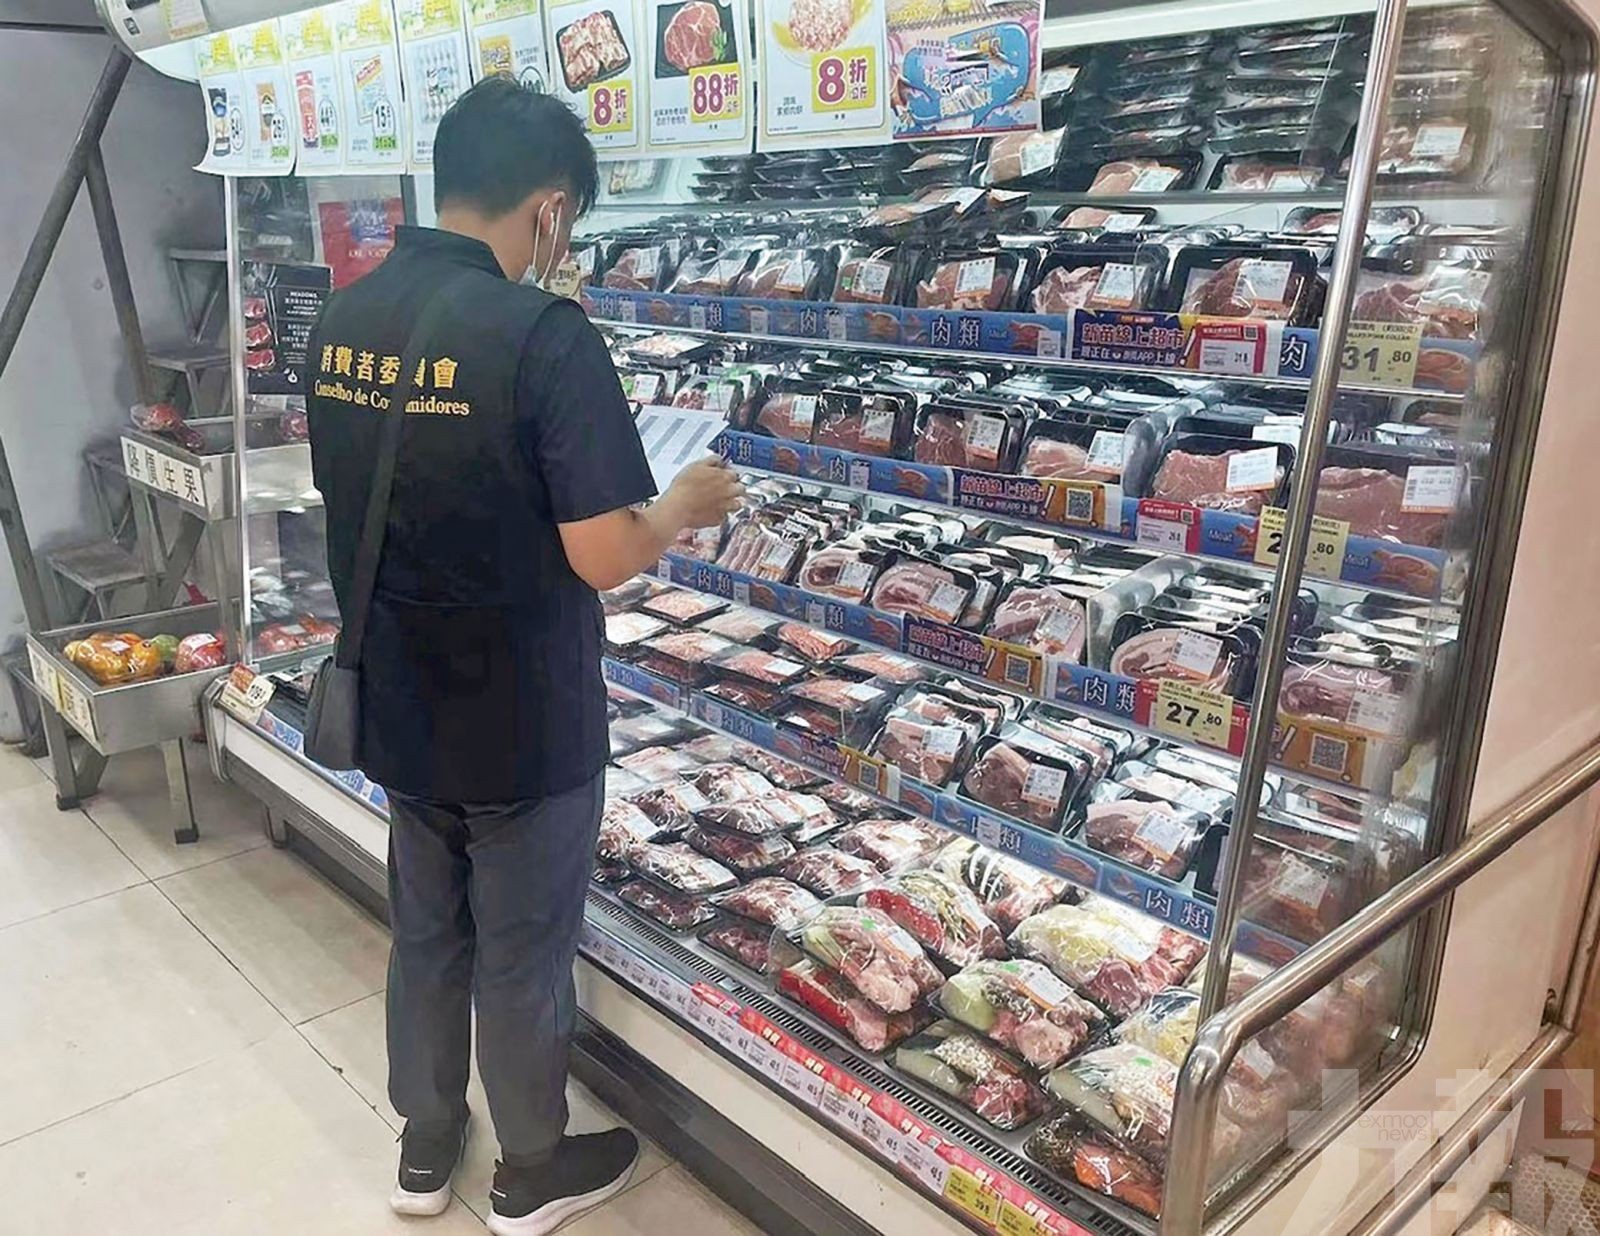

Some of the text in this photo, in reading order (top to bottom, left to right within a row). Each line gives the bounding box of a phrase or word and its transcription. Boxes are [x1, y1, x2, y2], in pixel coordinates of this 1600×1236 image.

[693, 72, 739, 115] 88折
[818, 58, 868, 103] 8折
[593, 88, 628, 126] 8折
[931, 316, 981, 348] 肉類
[354, 388, 369, 406] de
[1145, 887, 1212, 934] 肉類
